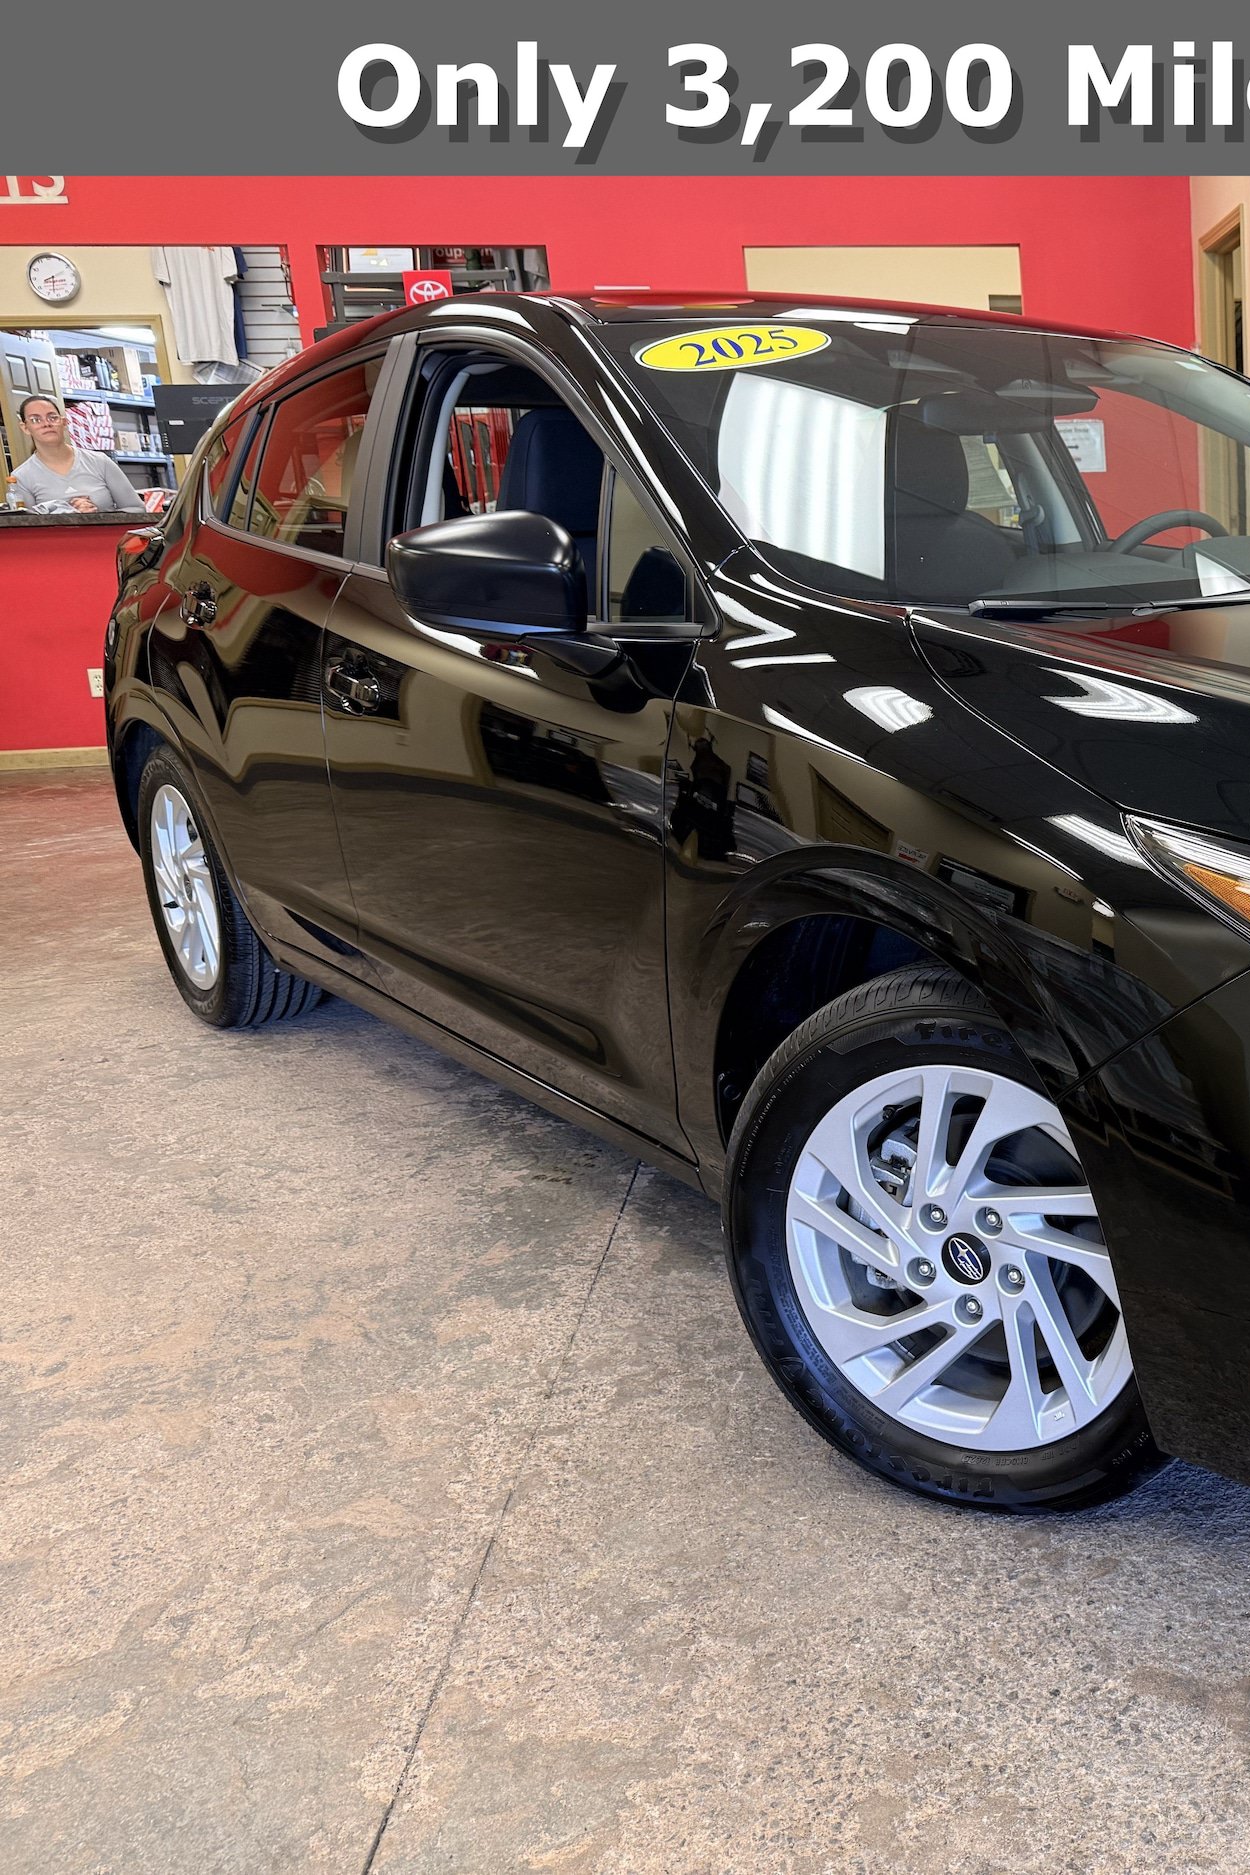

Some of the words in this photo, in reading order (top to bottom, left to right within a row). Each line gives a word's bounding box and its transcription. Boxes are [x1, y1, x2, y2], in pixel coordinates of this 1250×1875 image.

[679, 329, 799, 367] 2025
[192, 396, 235, 405] SCEPT
[914, 1018, 1013, 1052] Fire
